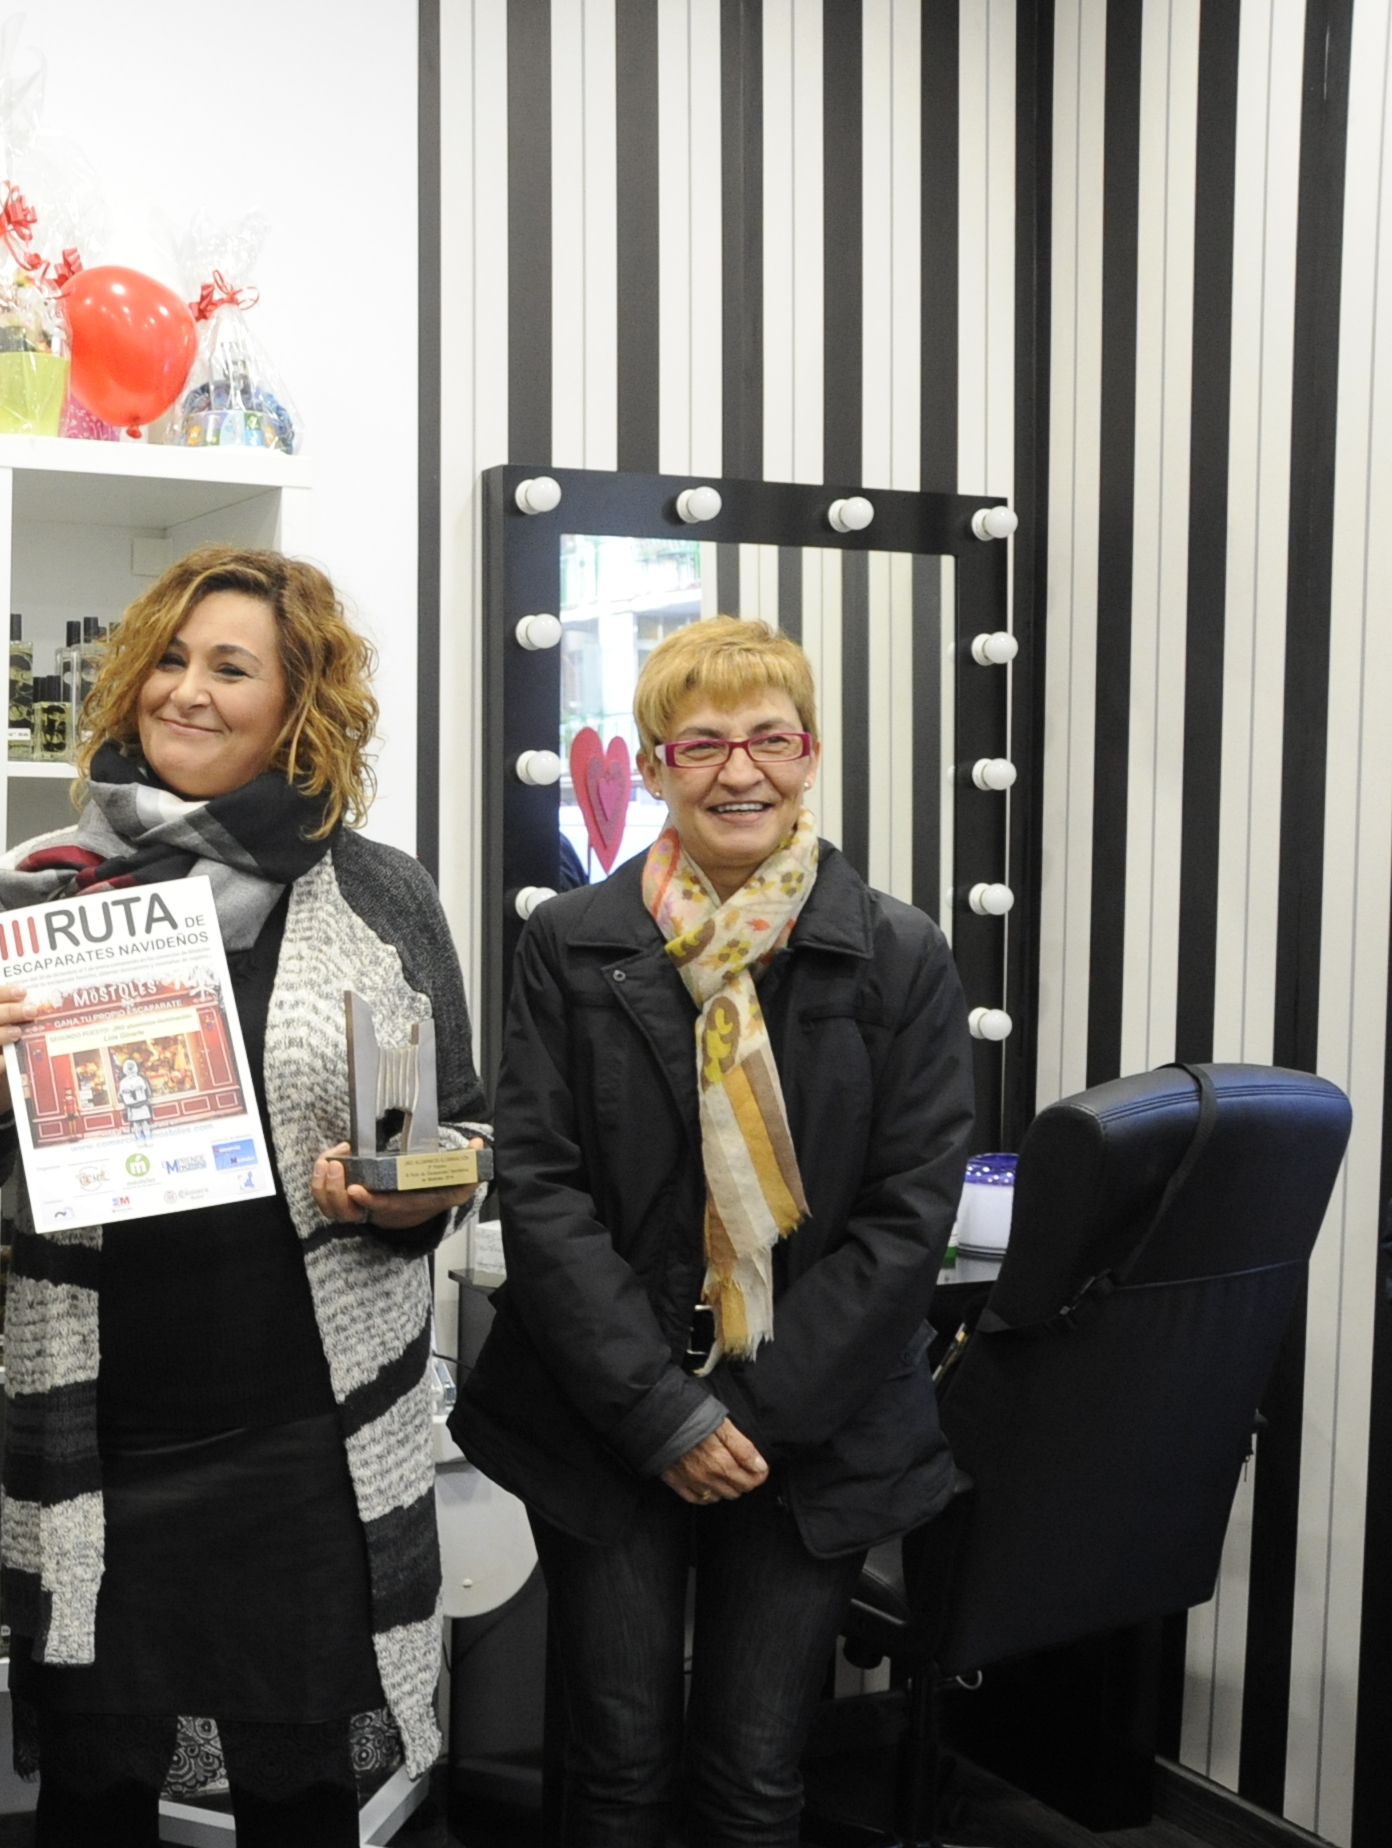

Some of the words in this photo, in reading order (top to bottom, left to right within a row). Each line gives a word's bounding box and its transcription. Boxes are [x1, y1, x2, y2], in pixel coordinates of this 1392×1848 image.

[44, 892, 179, 951] RUTA
[185, 914, 206, 929] DE
[2, 946, 116, 978] ESCAPARATES
[119, 930, 209, 957] NAVIDEÑOS
[81, 1015, 92, 1024] TU
